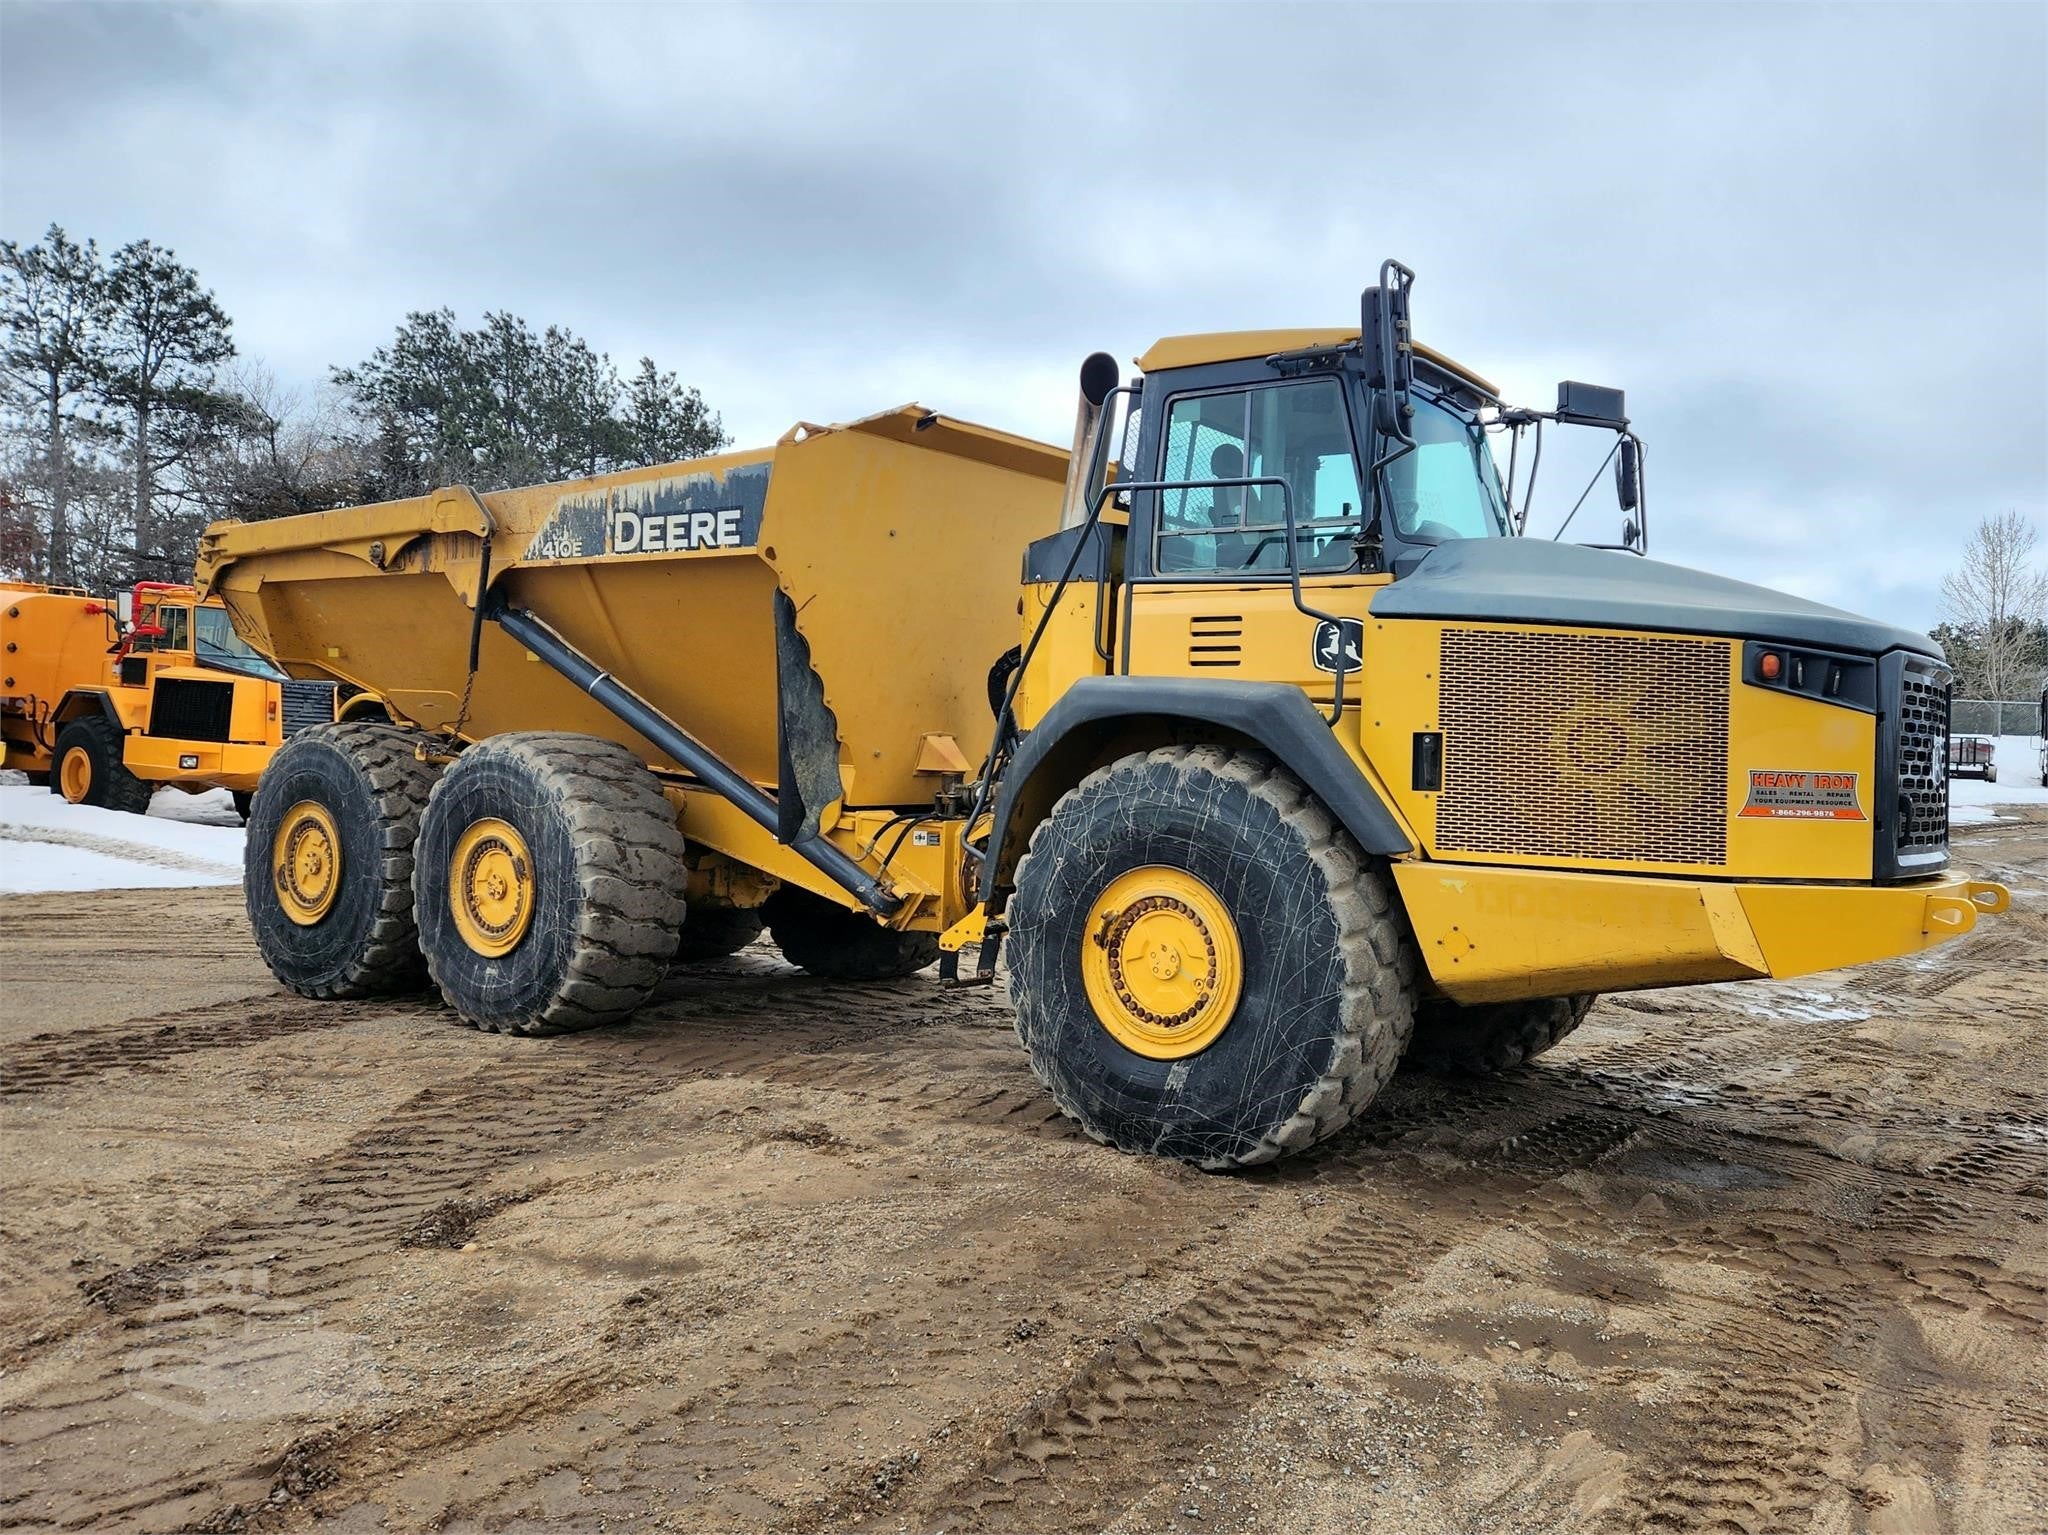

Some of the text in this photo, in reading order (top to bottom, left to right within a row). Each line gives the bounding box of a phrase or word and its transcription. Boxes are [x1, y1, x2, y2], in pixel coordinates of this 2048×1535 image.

[614, 509, 741, 552] DEERE
[541, 540, 583, 558] 410E
[1752, 773, 1854, 790] HEAVY IRON
